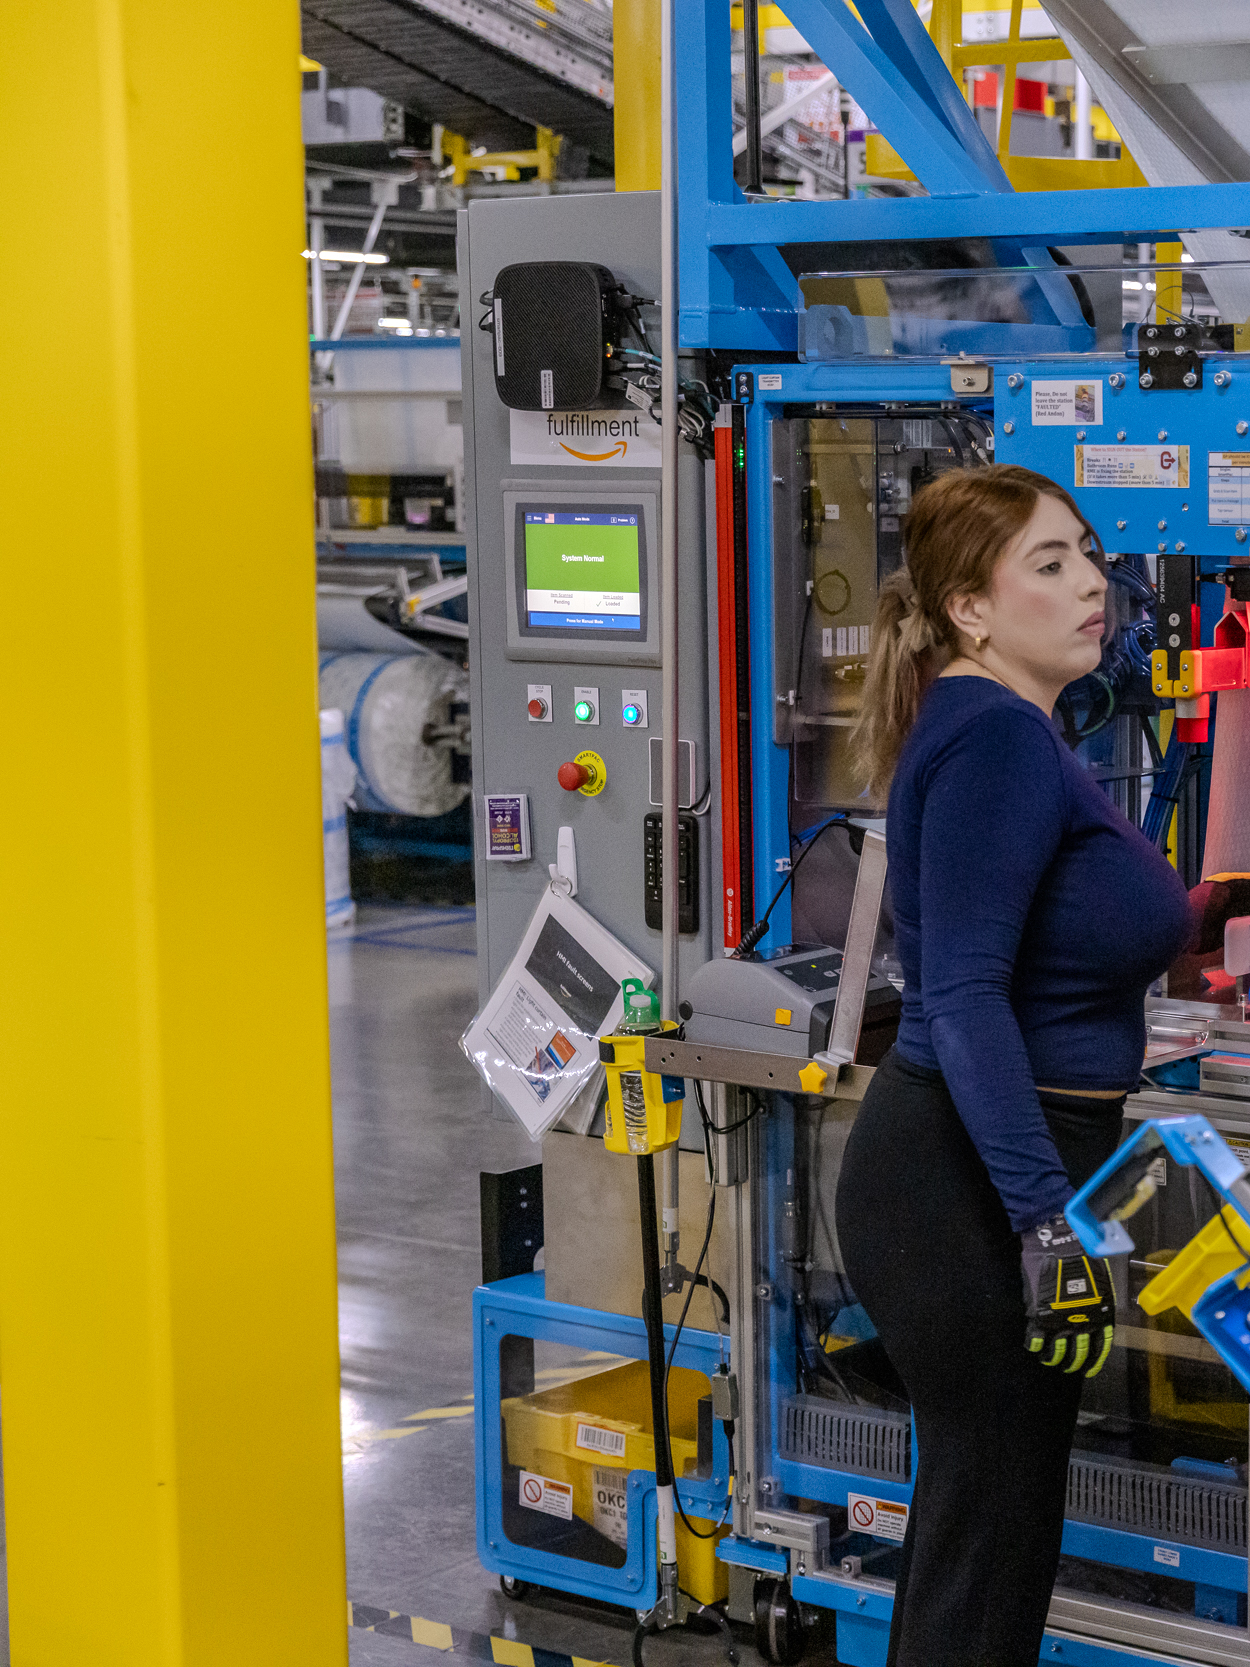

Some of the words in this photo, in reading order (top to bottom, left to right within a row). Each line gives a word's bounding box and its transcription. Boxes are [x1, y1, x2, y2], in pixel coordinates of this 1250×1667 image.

[547, 413, 639, 437] fulfillment
[561, 554, 582, 562] System
[577, 753, 600, 763] SMARTPAC
[557, 951, 566, 964] HMI
[566, 960, 578, 976] fault
[577, 972, 594, 992] screens
[515, 991, 525, 1003] fault
[525, 994, 534, 1008] Light
[534, 1005, 547, 1020] curtain
[598, 1491, 625, 1509] OKC
[891, 1514, 903, 1522] injury
